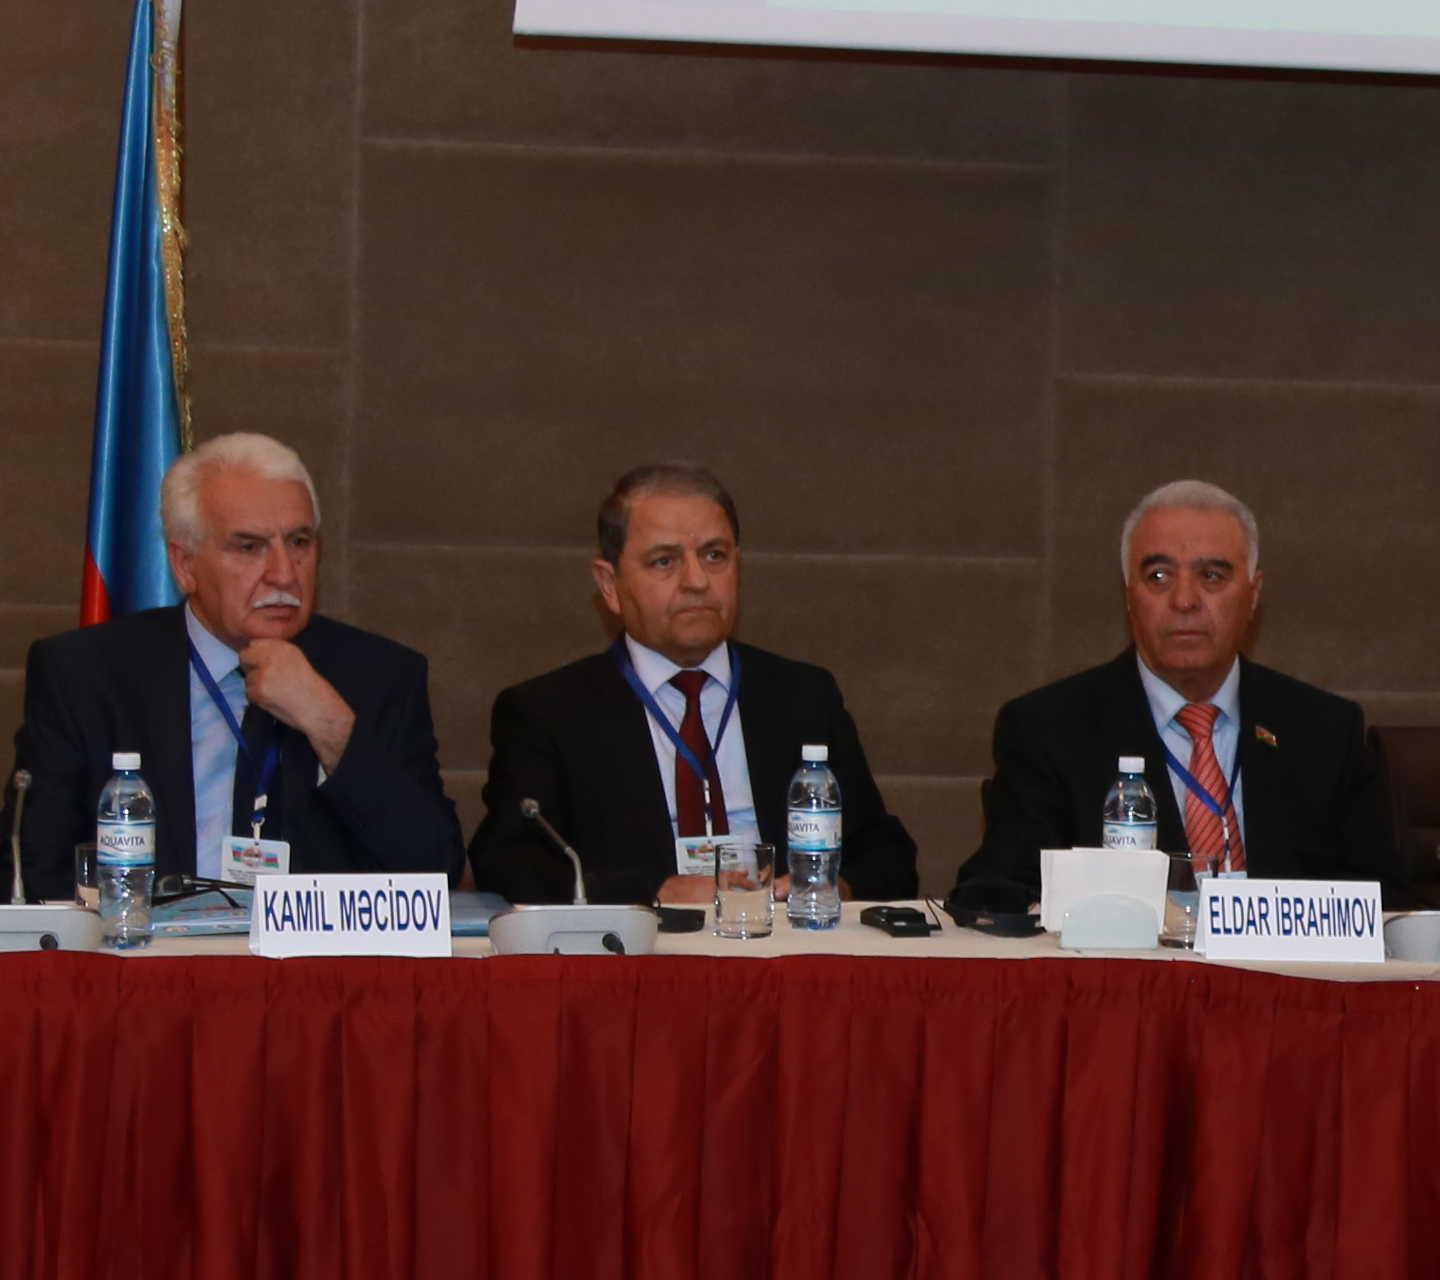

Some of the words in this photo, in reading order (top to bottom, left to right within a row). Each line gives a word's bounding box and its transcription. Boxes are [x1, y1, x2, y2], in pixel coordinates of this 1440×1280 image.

[100, 835, 145, 846] AQUAVITA
[264, 880, 333, 931] KAMİL
[340, 880, 441, 931] MƏCİDOV
[1210, 896, 1271, 935] ELDAR
[1275, 887, 1375, 937] İBRAHİMOV
